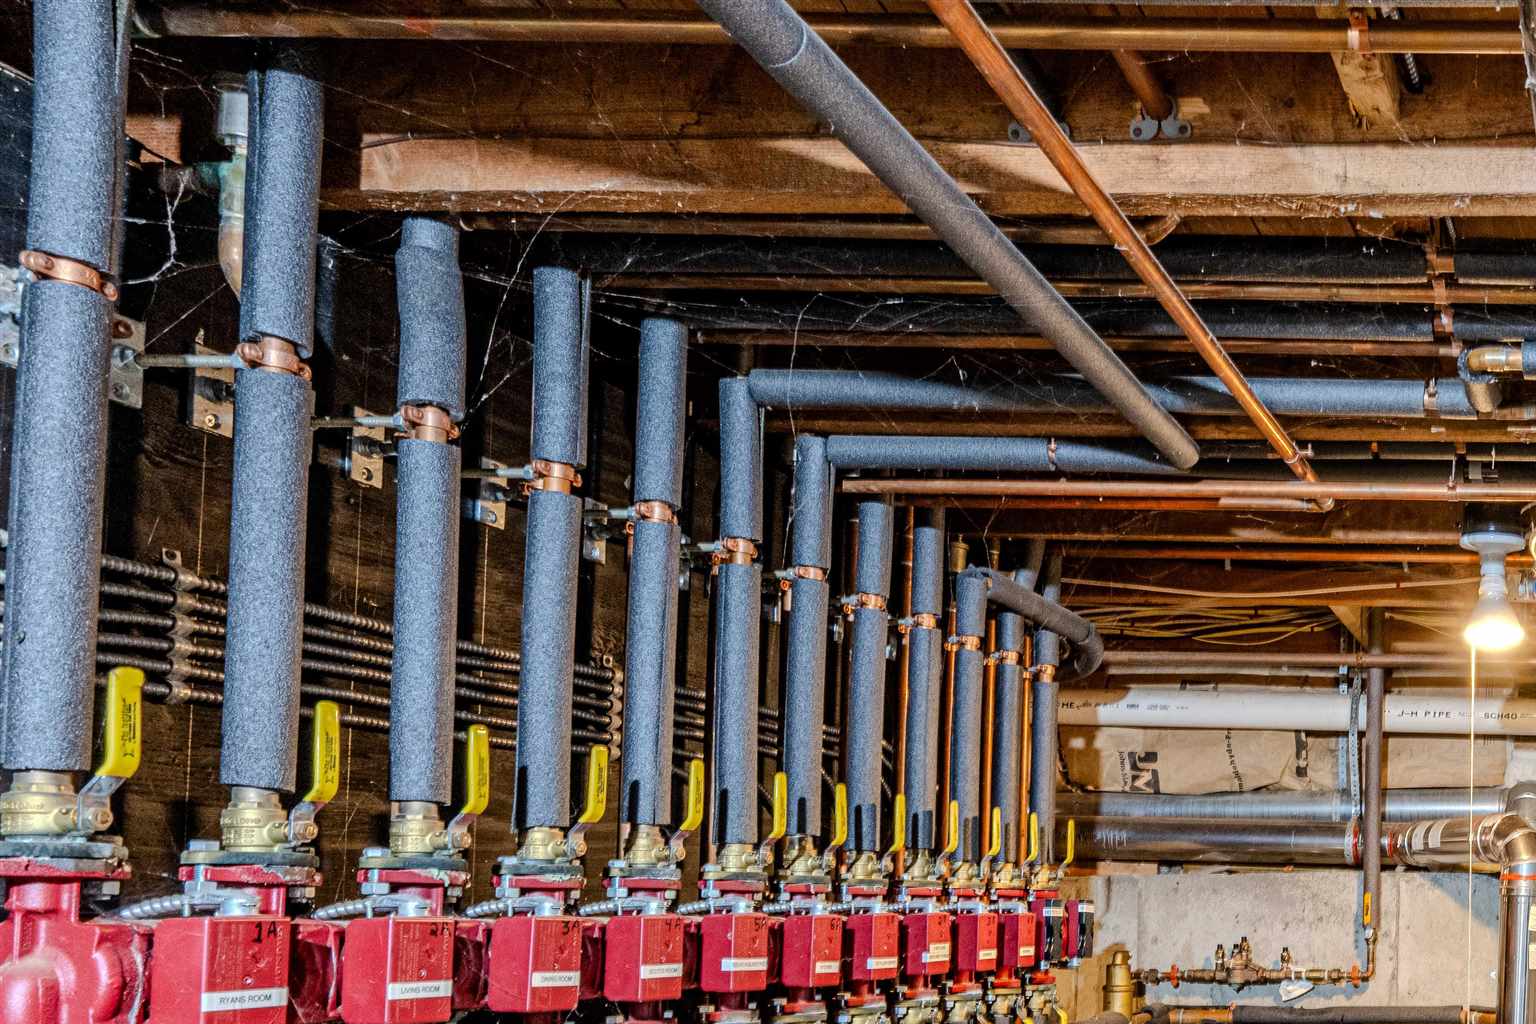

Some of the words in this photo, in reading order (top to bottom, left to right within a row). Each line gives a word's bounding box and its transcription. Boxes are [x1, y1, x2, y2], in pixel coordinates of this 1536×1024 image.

[1424, 711, 1452, 719] PIPE
[421, 984, 441, 993] ROOM
[219, 995, 246, 1005] RYANS
[248, 993, 272, 1003] ROOM
